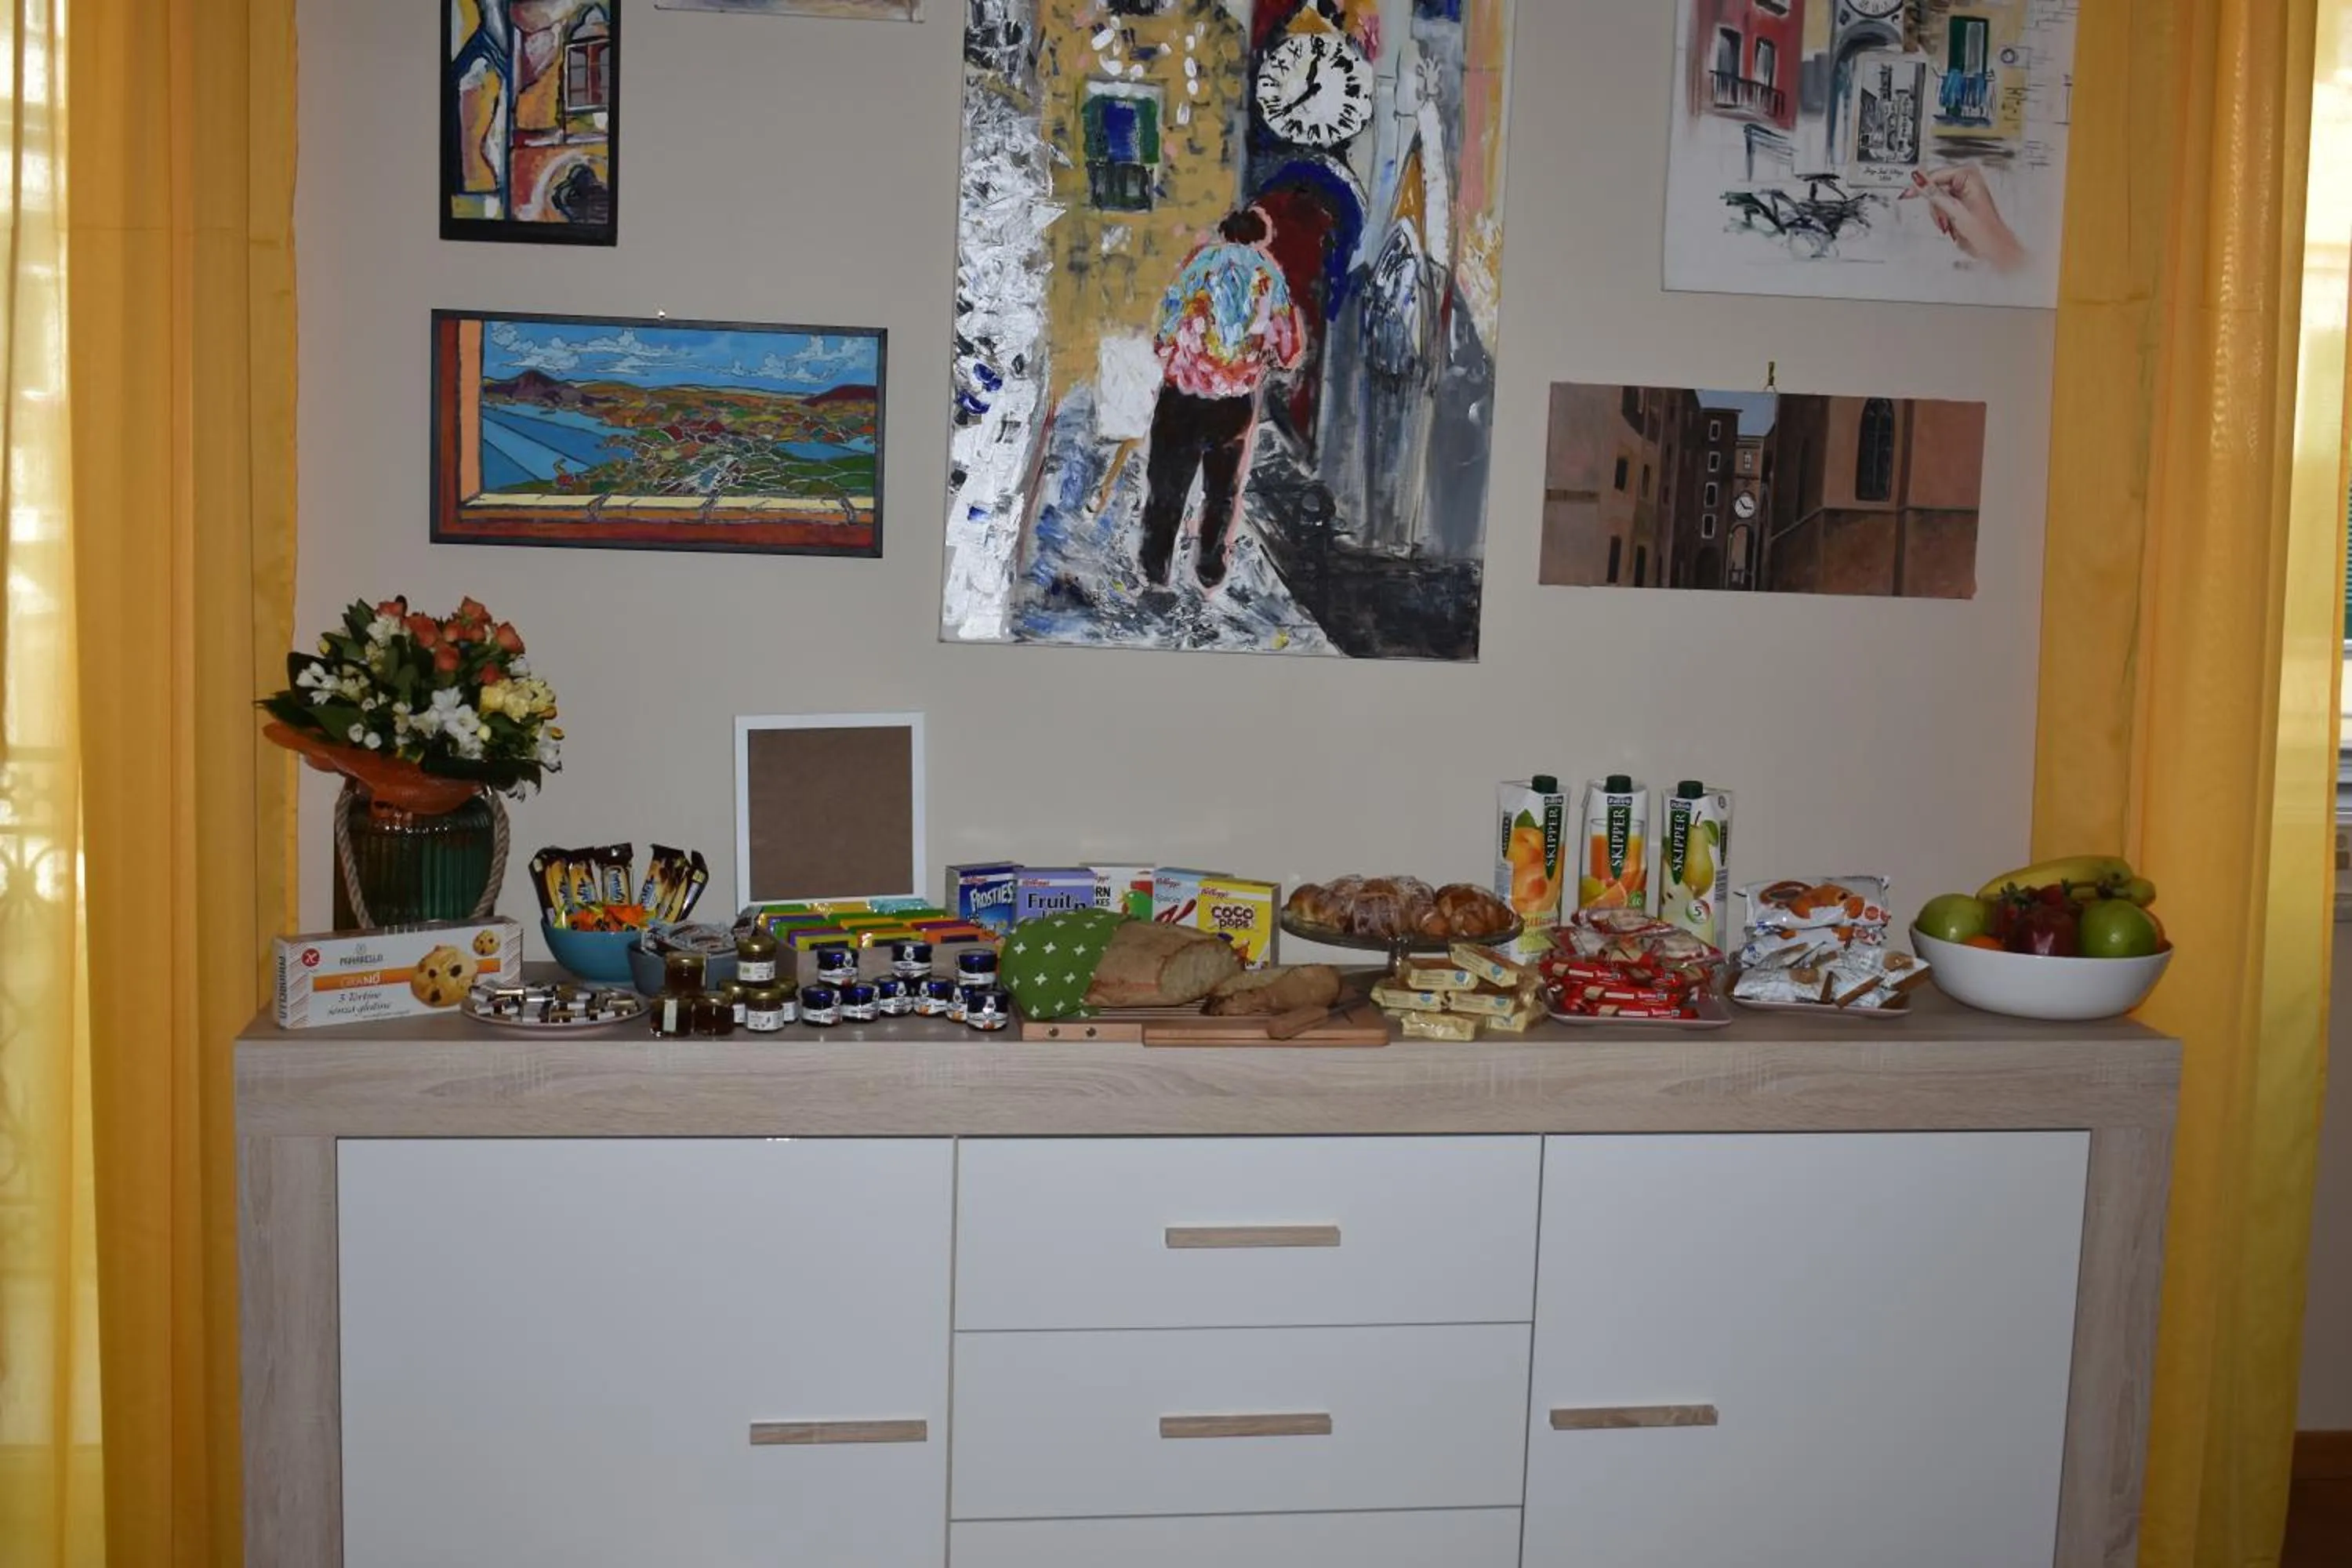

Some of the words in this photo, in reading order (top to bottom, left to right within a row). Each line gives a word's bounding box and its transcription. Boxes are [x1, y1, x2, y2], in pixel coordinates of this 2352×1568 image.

[1545, 808, 1558, 866] SKIPPER
[1611, 808, 1626, 866] SKIPPER
[1672, 814, 1686, 873] SKIPPER
[970, 881, 1014, 913] FROSTIES
[1028, 891, 1072, 909] Fruit
[1095, 886, 1111, 898] RN
[1693, 906, 1701, 916] 5
